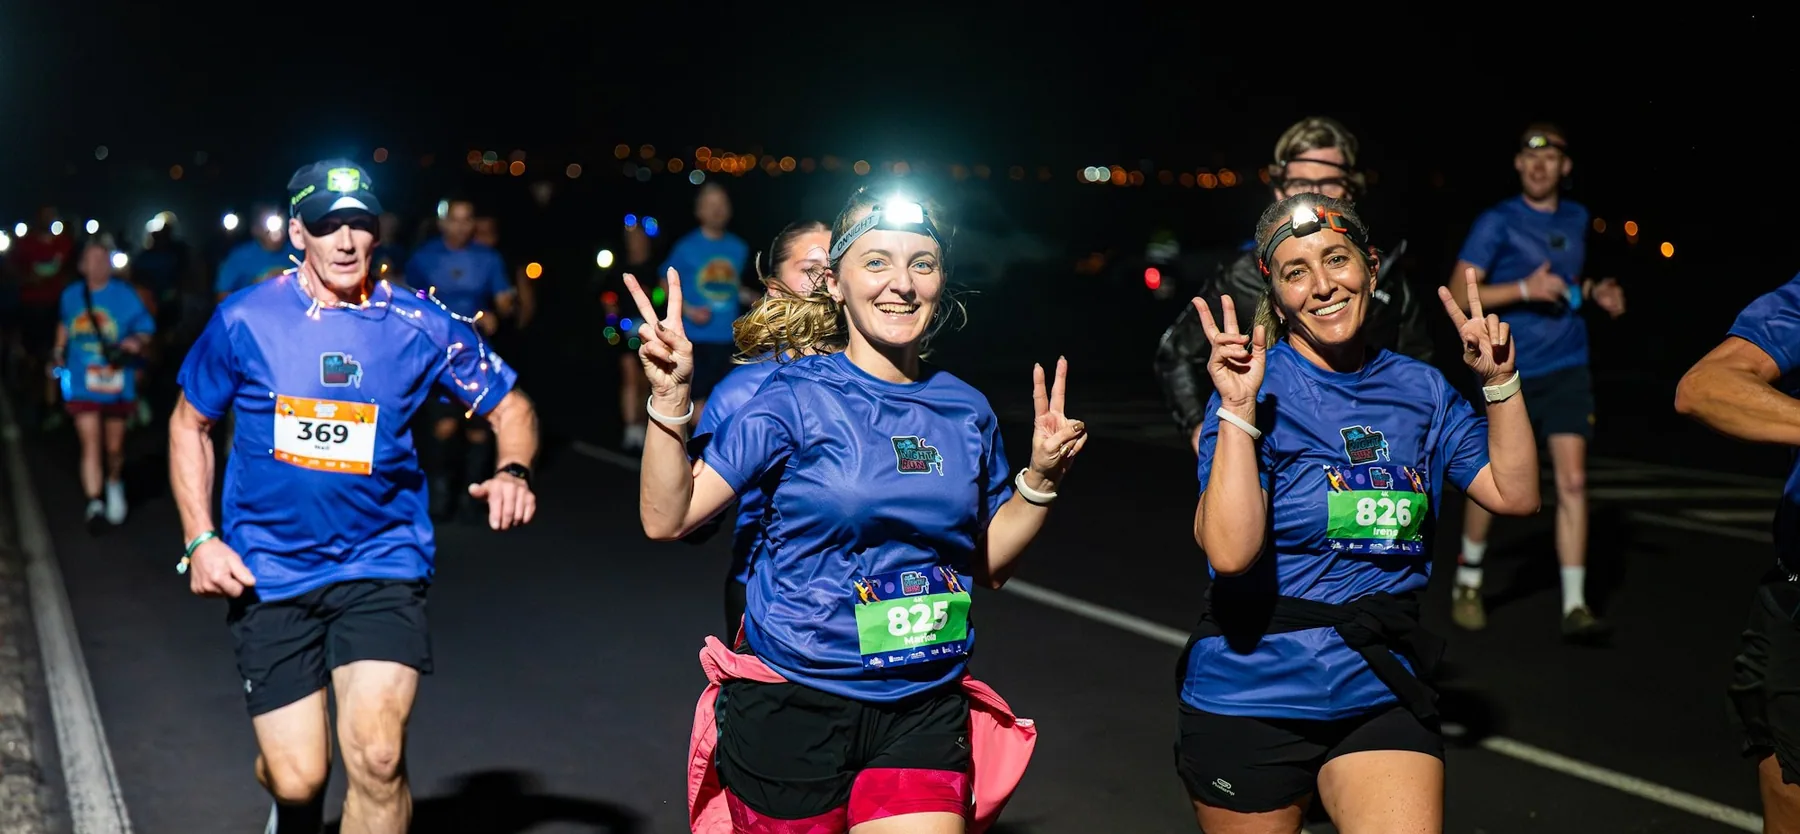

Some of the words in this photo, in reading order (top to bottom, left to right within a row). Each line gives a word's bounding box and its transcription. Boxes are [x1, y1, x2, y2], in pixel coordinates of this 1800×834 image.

[837, 215, 875, 251] ONNIGHT
[297, 421, 349, 444] 369
[901, 450, 935, 460] NIGHT
[902, 459, 926, 470] RUN
[1356, 497, 1412, 527] 826
[1373, 528, 1399, 537] Irene
[887, 601, 949, 637] 825
